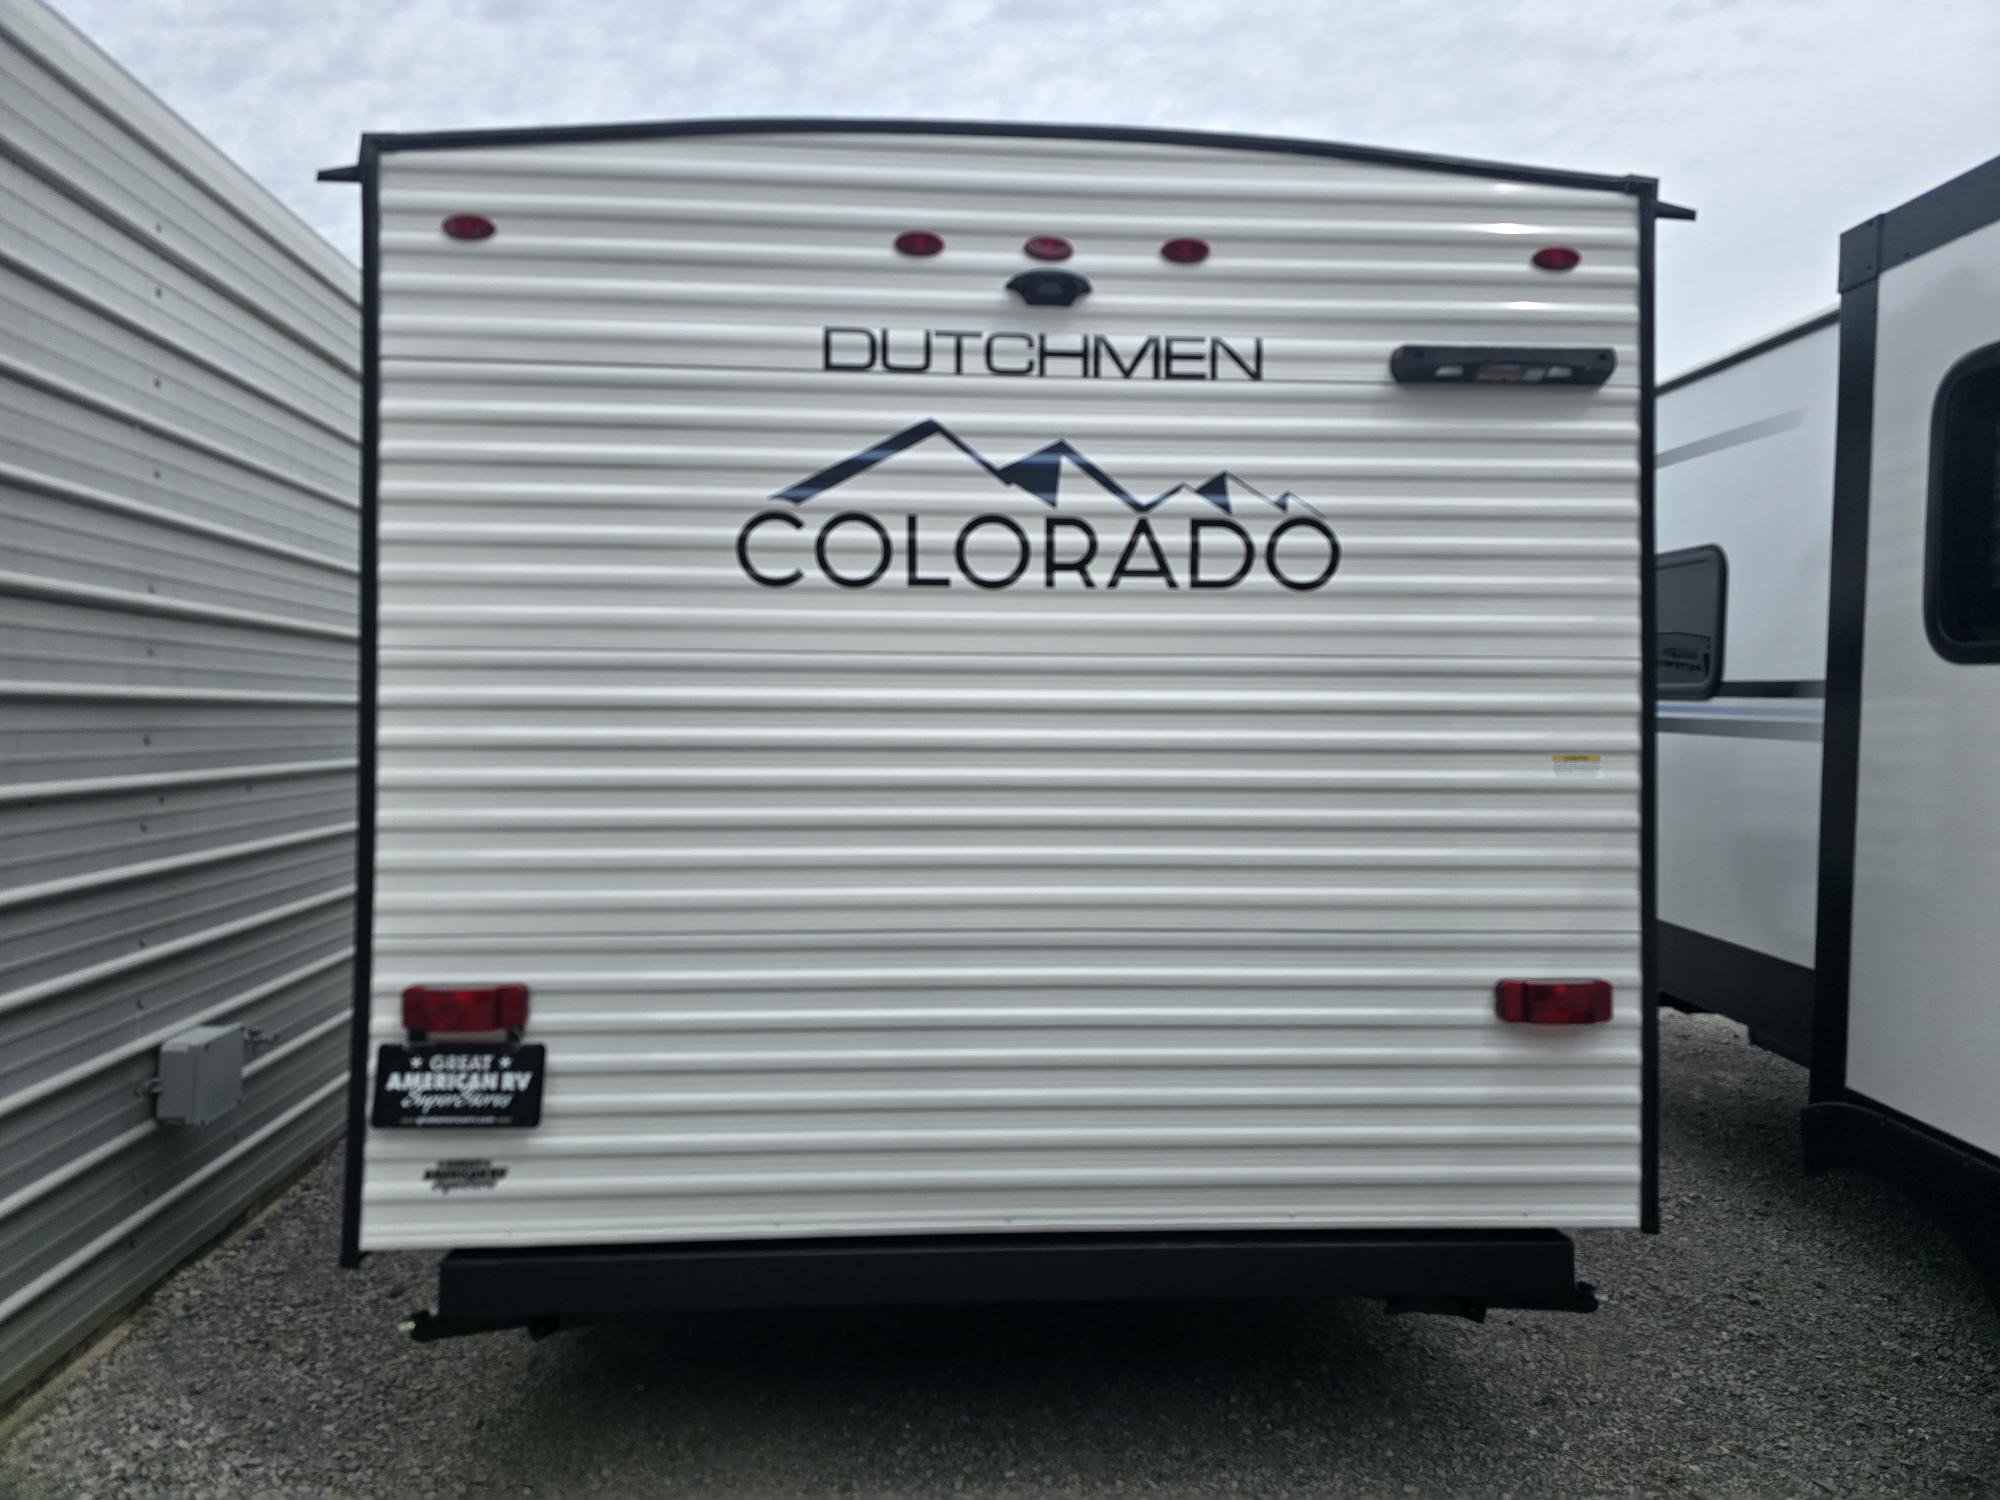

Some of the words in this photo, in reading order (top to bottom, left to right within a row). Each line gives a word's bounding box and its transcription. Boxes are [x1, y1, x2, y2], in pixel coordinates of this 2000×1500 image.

[823, 326, 1263, 380] DUTCHMEN
[736, 510, 1341, 590] COLORADO
[429, 1054, 495, 1071] GREAT
[385, 1071, 498, 1092] AMERICAN
[501, 1071, 534, 1091] RV
